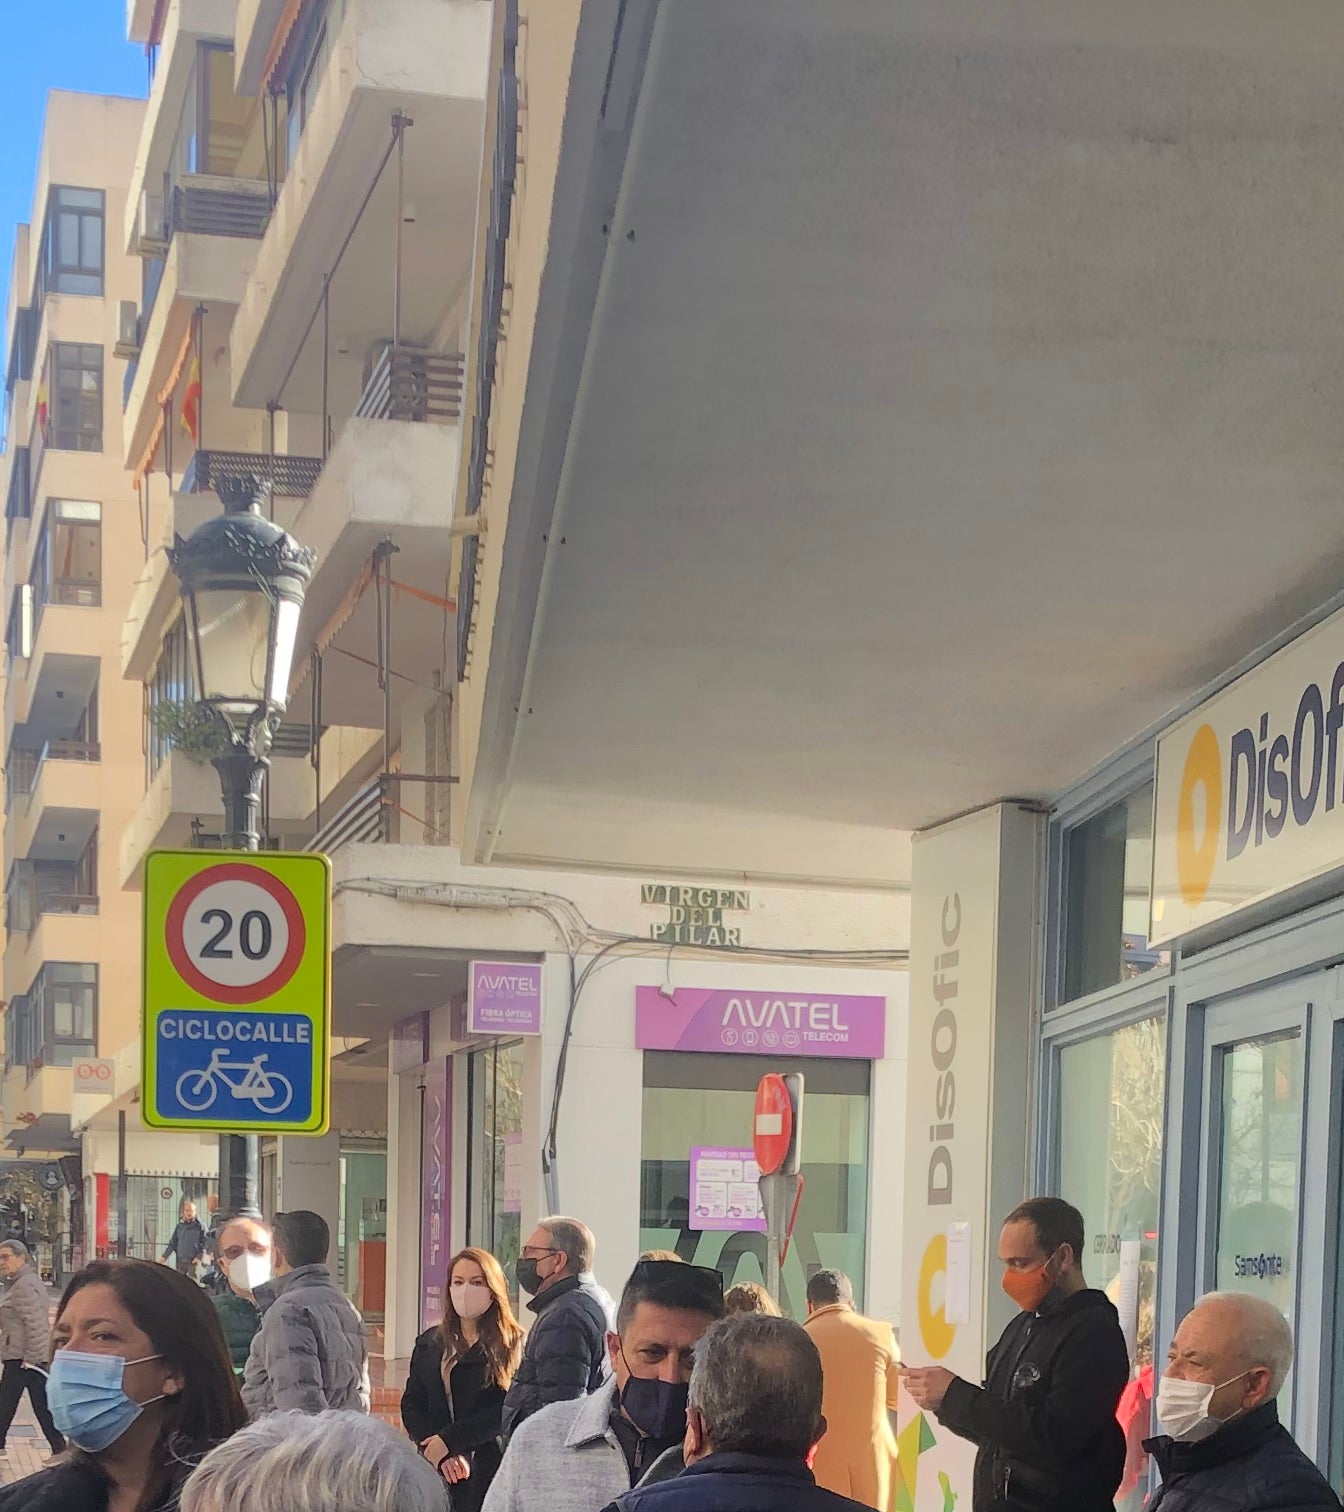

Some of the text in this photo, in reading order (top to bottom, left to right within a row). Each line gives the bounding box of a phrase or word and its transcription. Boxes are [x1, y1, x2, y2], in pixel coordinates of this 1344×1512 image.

[642, 885, 750, 910] VIRGEN
[671, 908, 722, 926] DEL
[199, 908, 272, 961] 20
[652, 924, 741, 946] PILAR
[477, 975, 537, 992] AVATEL
[480, 1008, 504, 1018] FIBRA
[721, 998, 849, 1031] AVATEL
[159, 1018, 310, 1045] CICLOCALLE
[802, 1031, 849, 1043] TELECOM
